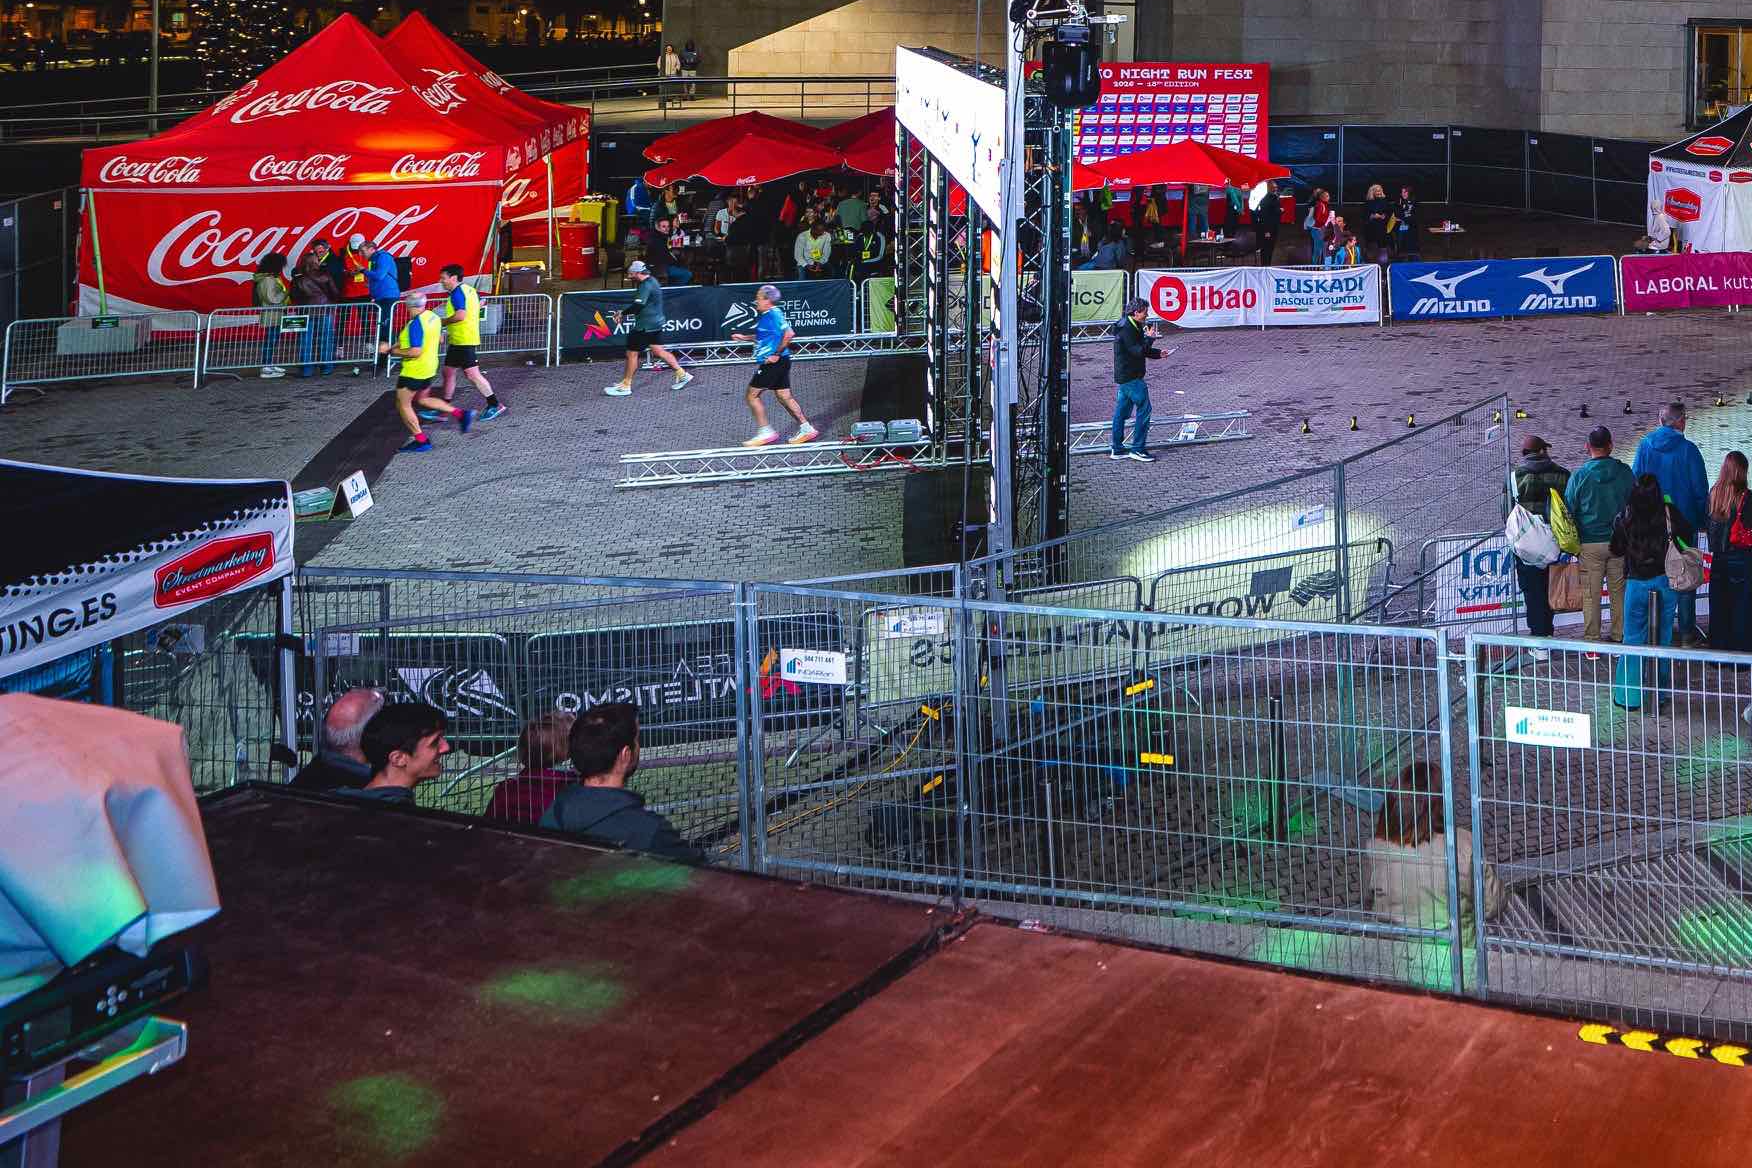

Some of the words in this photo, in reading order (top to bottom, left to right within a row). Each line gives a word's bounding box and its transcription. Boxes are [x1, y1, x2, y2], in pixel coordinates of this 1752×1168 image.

[1120, 68, 1170, 79] NIGHT
[1177, 69, 1207, 80] RUN
[1214, 69, 1253, 80] FEST
[230, 80, 404, 124] Coca-Cola
[99, 155, 208, 184] Coca-Cola
[249, 153, 351, 181] Coca-Cola
[390, 152, 487, 180] Coca-Cola
[1155, 279, 1257, 316] Bilbao
[1274, 276, 1364, 294] EUSKADI
[1635, 275, 1718, 295] LABORAL
[1274, 296, 1314, 306] BASQUE
[1317, 294, 1365, 305] COUNTRY
[783, 310, 829, 320] LETISMO
[794, 317, 837, 327] RUNNING
[162, 547, 267, 593] Streetmarketing
[176, 581, 202, 597] EVENT
[205, 567, 246, 585] COMPANY
